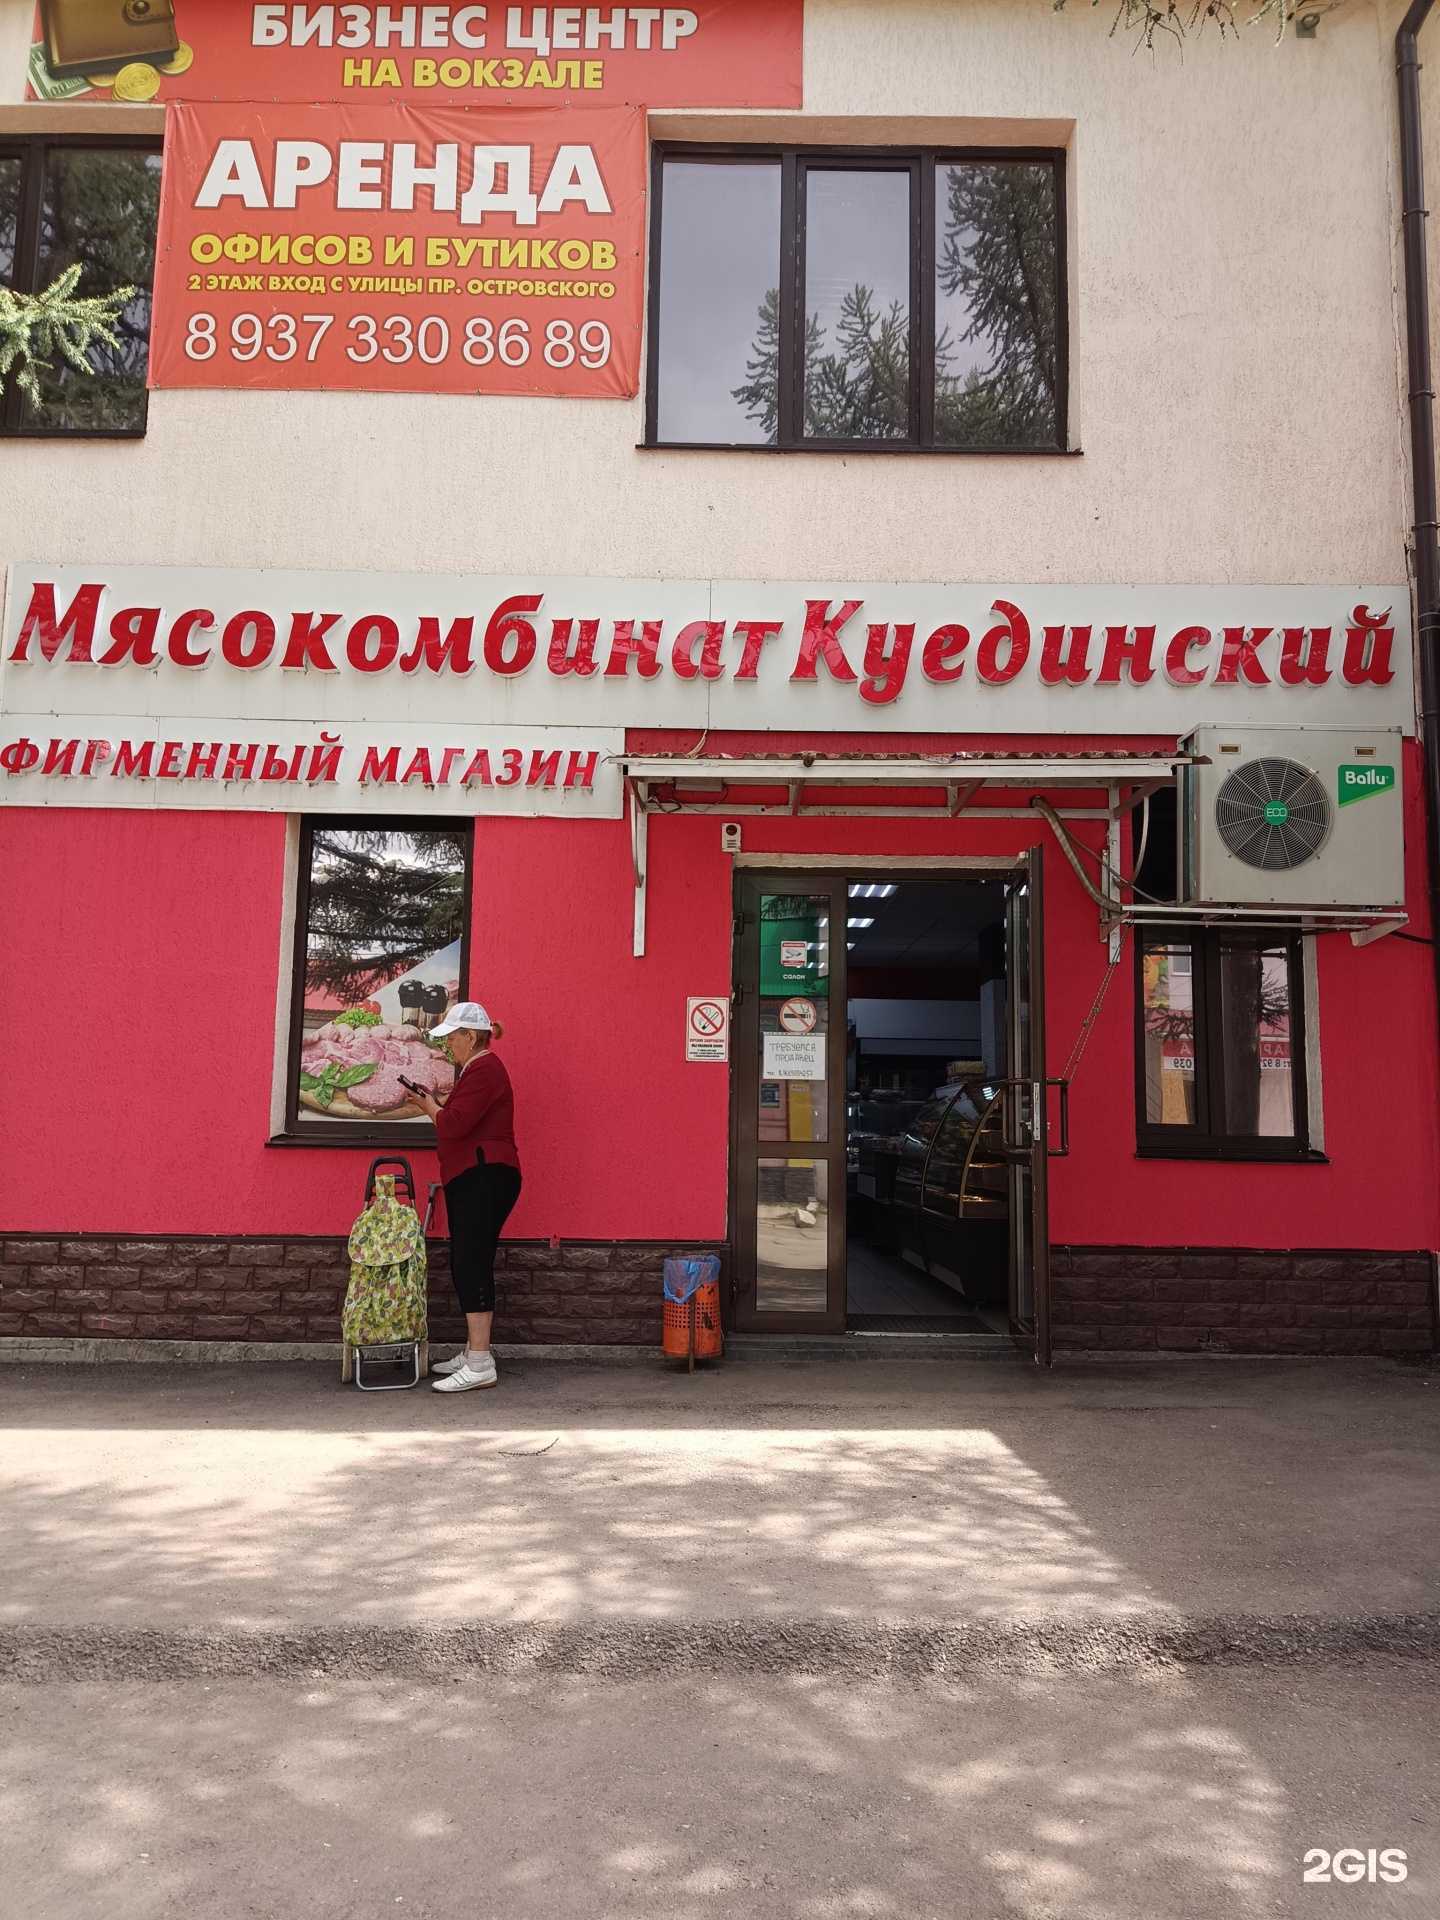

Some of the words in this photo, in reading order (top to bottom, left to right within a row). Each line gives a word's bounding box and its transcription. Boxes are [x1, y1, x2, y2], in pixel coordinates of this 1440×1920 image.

[251, 4, 486, 49] БИЗНЕС
[505, 7, 699, 57] ЦЕНТР
[342, 58, 402, 87] НА
[412, 58, 604, 89] ВОКЗАЛЕ
[194, 139, 613, 226] АРЕНДА
[190, 233, 373, 265] ОФИСОВ
[384, 236, 414, 266] И
[426, 237, 617, 270] БУТИКОВ
[188, 274, 201, 290] 2
[206, 275, 264, 290] ЭТАЖ
[268, 275, 326, 294] ВХОД
[330, 276, 343, 291] С
[348, 276, 423, 295] УЛИЦЫ
[428, 278, 462, 294] ПР.
[467, 279, 615, 298] ОСТРОВСКОГО
[185, 313, 217, 361] 8
[231, 313, 335, 362] 937
[346, 315, 449, 364] 330
[463, 317, 530, 366] 86
[543, 320, 611, 369] 89
[8, 582, 783, 680] Мясокомбинат
[790, 599, 1396, 705] Куединский
[0, 731, 345, 785] ФИРМЕННЫЙ
[358, 745, 600, 788] МАГАЗИН
[1345, 769, 1386, 785] Ballu
[1266, 807, 1288, 818] ECO
